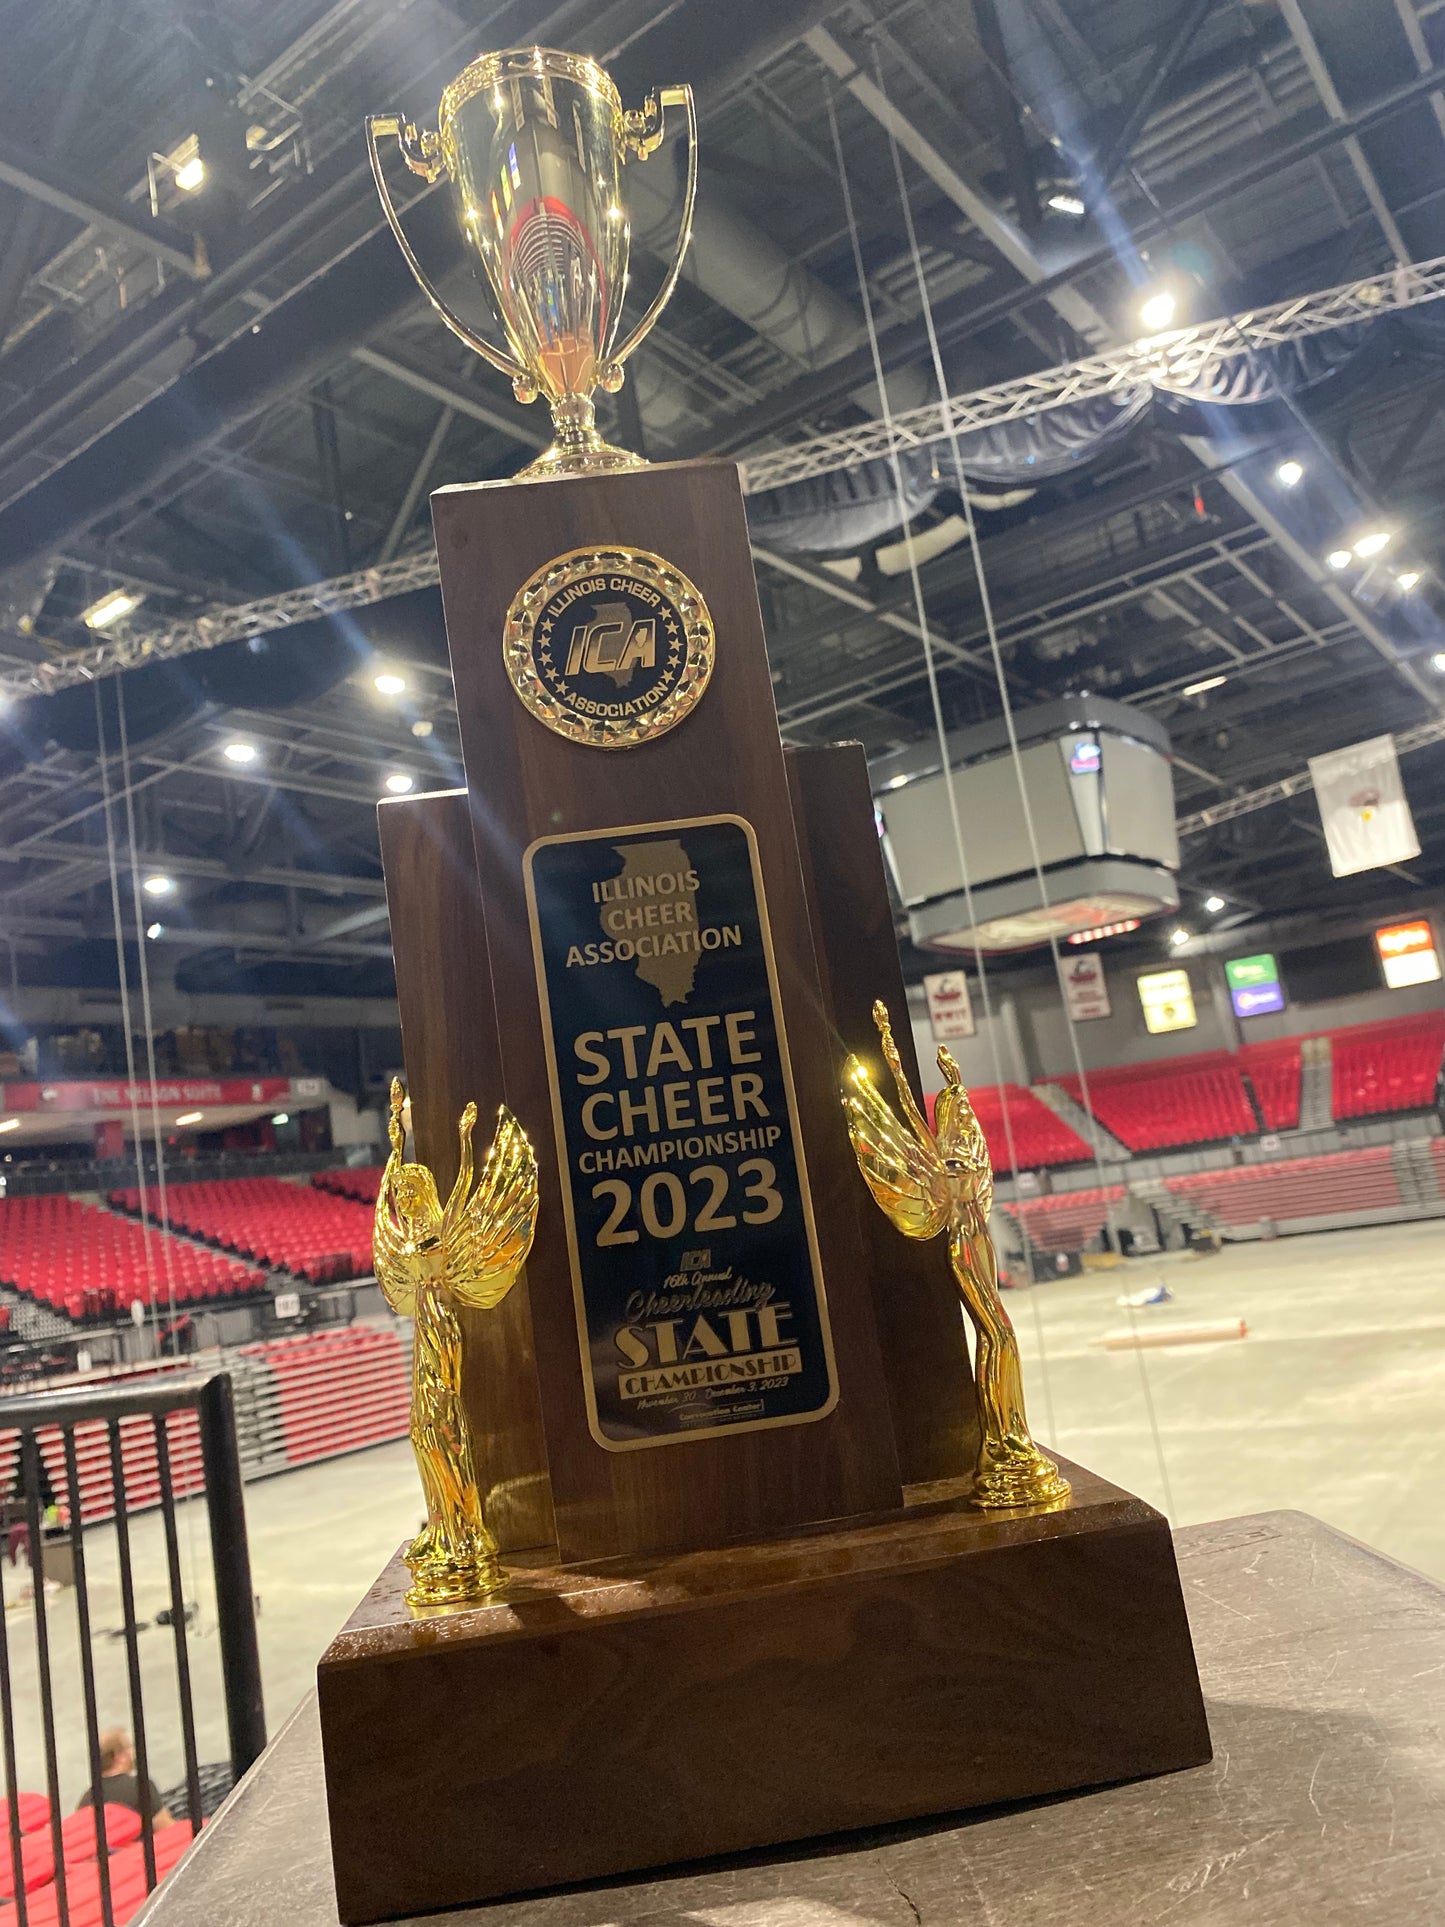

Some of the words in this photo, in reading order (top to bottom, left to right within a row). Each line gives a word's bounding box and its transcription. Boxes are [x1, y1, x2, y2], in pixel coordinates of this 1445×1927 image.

[547, 578, 606, 617] ILLINOIS
[609, 578, 661, 607] CHEER
[565, 618, 656, 676] ICA
[563, 681, 669, 718] ASSOCIATION
[592, 869, 700, 903] ILLINOIS
[607, 901, 694, 931] CHEER
[566, 924, 742, 967] ASSOCIATION
[573, 1010, 762, 1086] STATE
[581, 1072, 770, 1140] CHEER
[578, 1125, 782, 1174] CHAMPIONSHIP
[591, 1157, 783, 1247] 2023
[691, 1266, 733, 1286] Annual
[625, 1274, 776, 1323] Cheerleading
[614, 1302, 798, 1370] STATE
[624, 1353, 797, 1395] CHAMPIONSHIP
[759, 1377, 789, 1391] 2023
